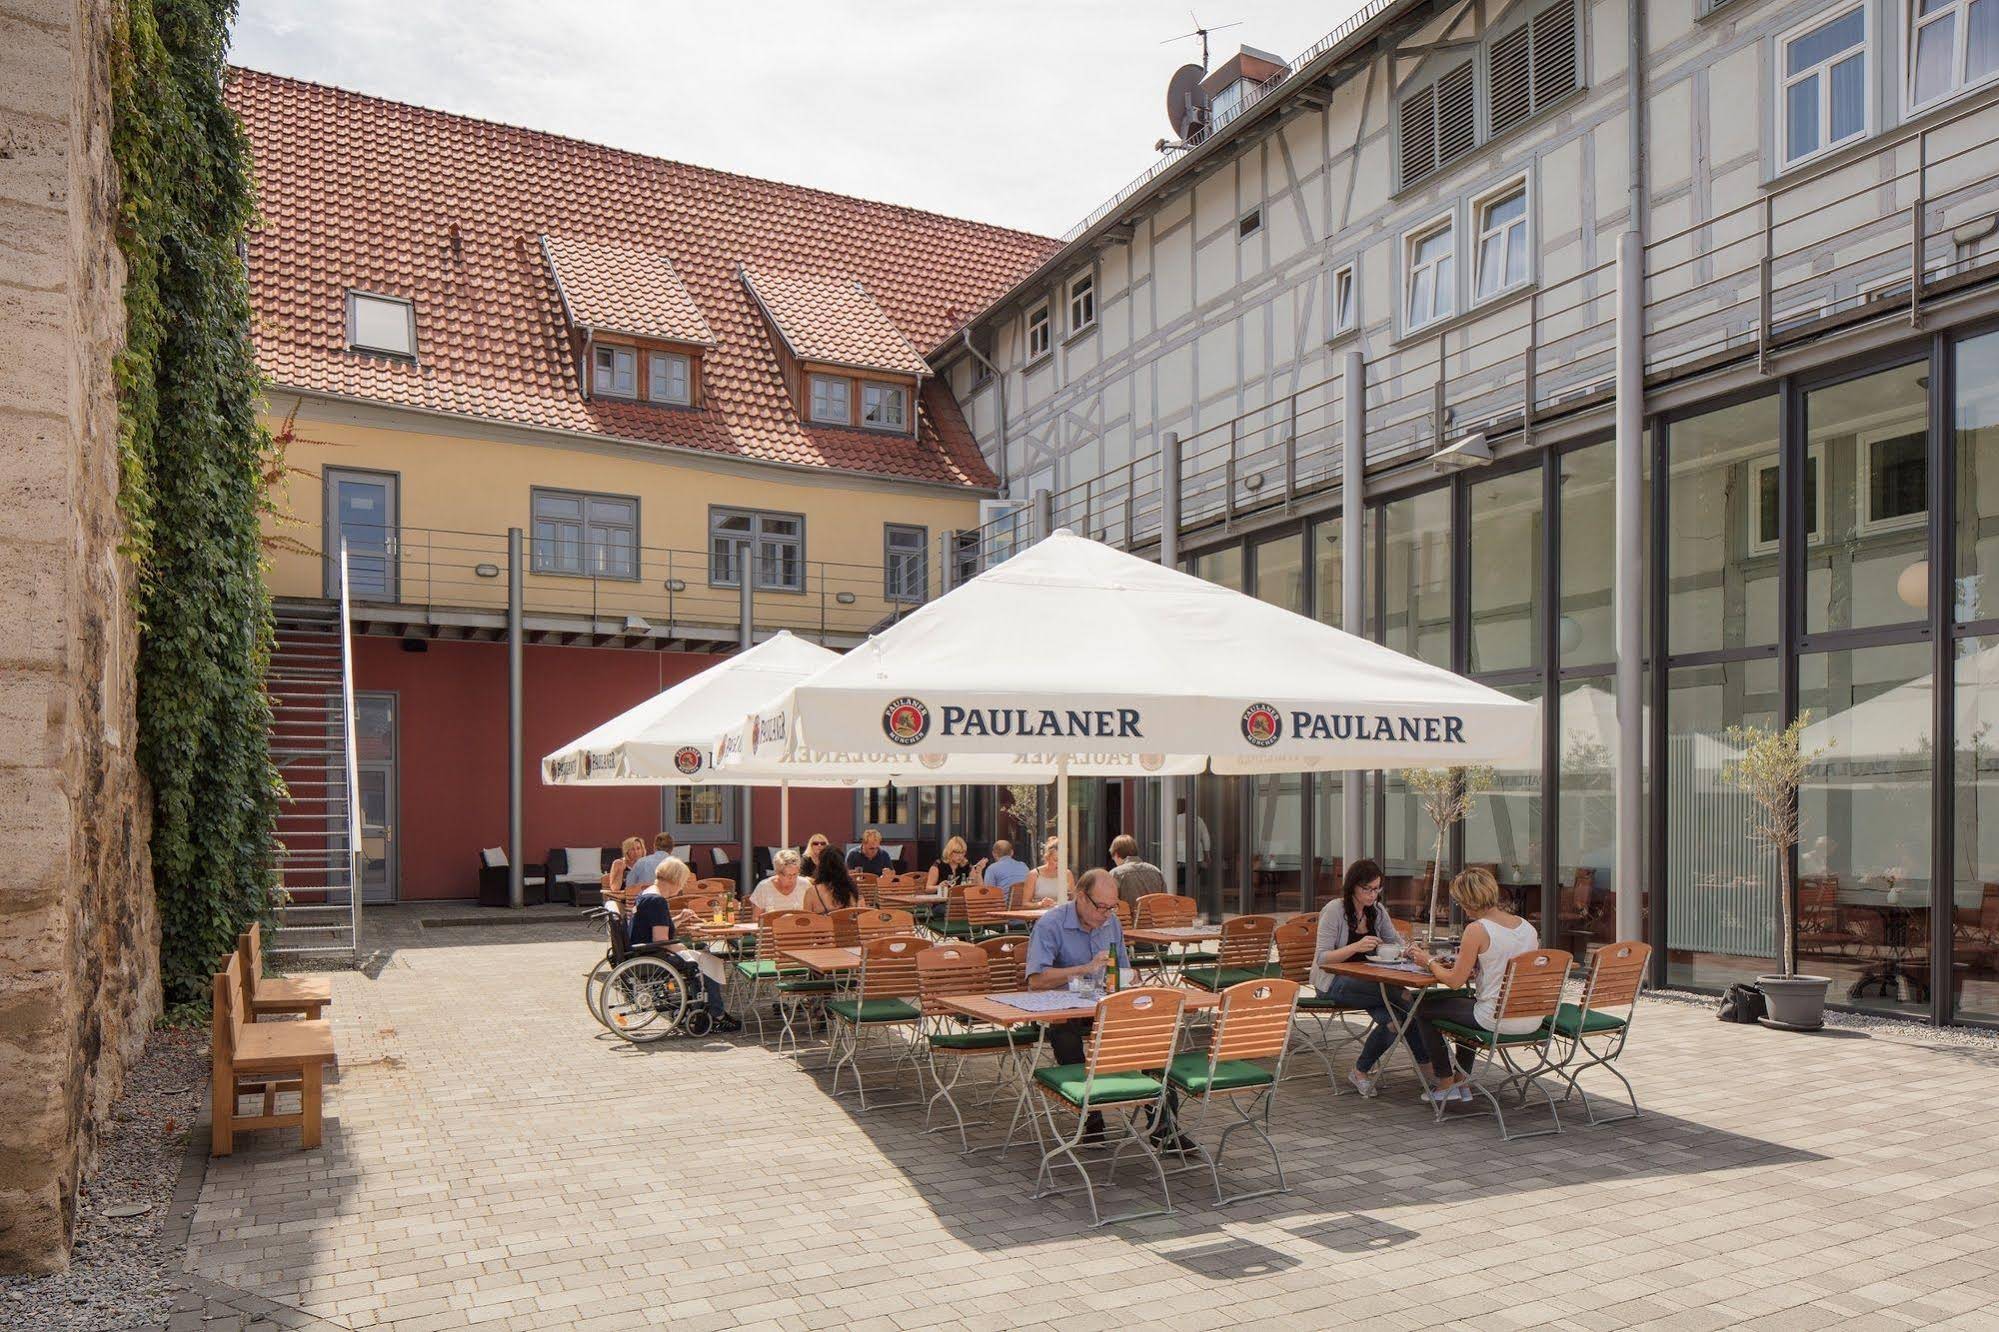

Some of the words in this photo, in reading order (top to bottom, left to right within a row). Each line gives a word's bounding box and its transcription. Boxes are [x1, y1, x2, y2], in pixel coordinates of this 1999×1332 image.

[885, 699, 928, 717] PAULANER
[1243, 704, 1280, 721] PAULANER
[940, 705, 1145, 738] PAULANER
[1290, 711, 1467, 743] PAULANER
